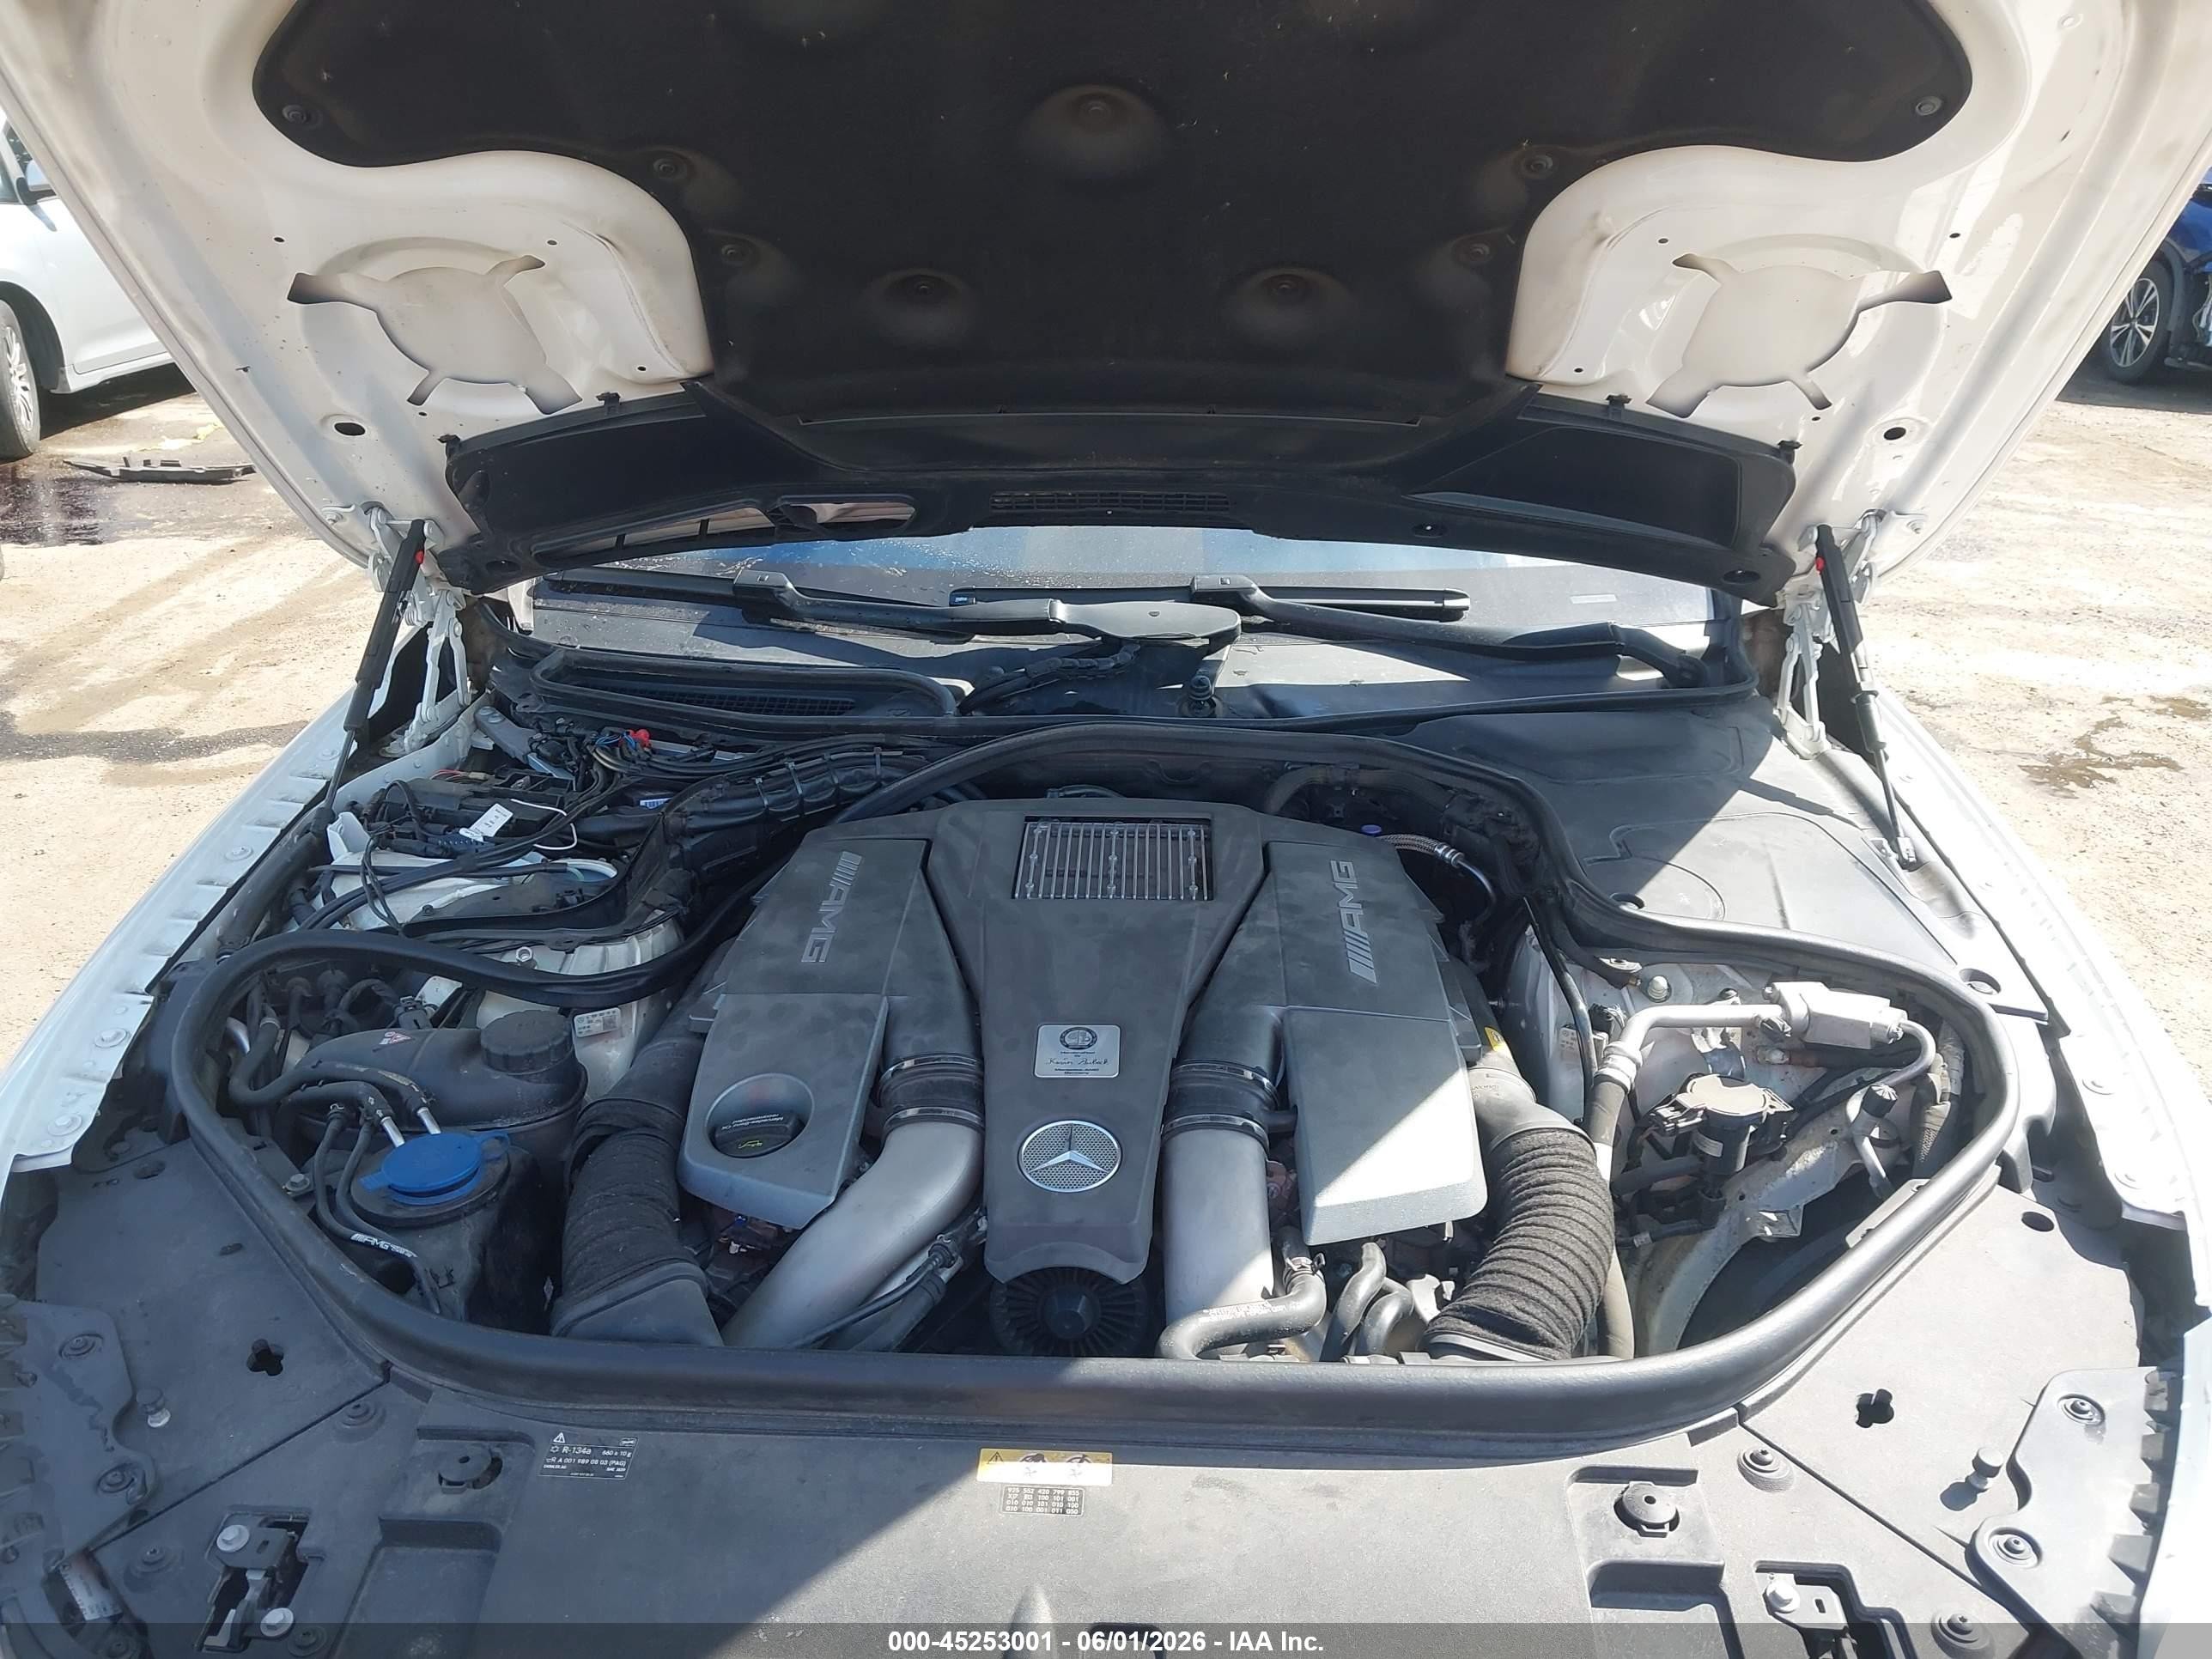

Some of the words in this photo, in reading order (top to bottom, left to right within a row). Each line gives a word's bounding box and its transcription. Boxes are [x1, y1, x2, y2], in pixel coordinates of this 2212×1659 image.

[800, 878, 851, 963] AMG
[1330, 859, 1368, 939] AMG
[562, 1446, 592, 1455] R-134a
